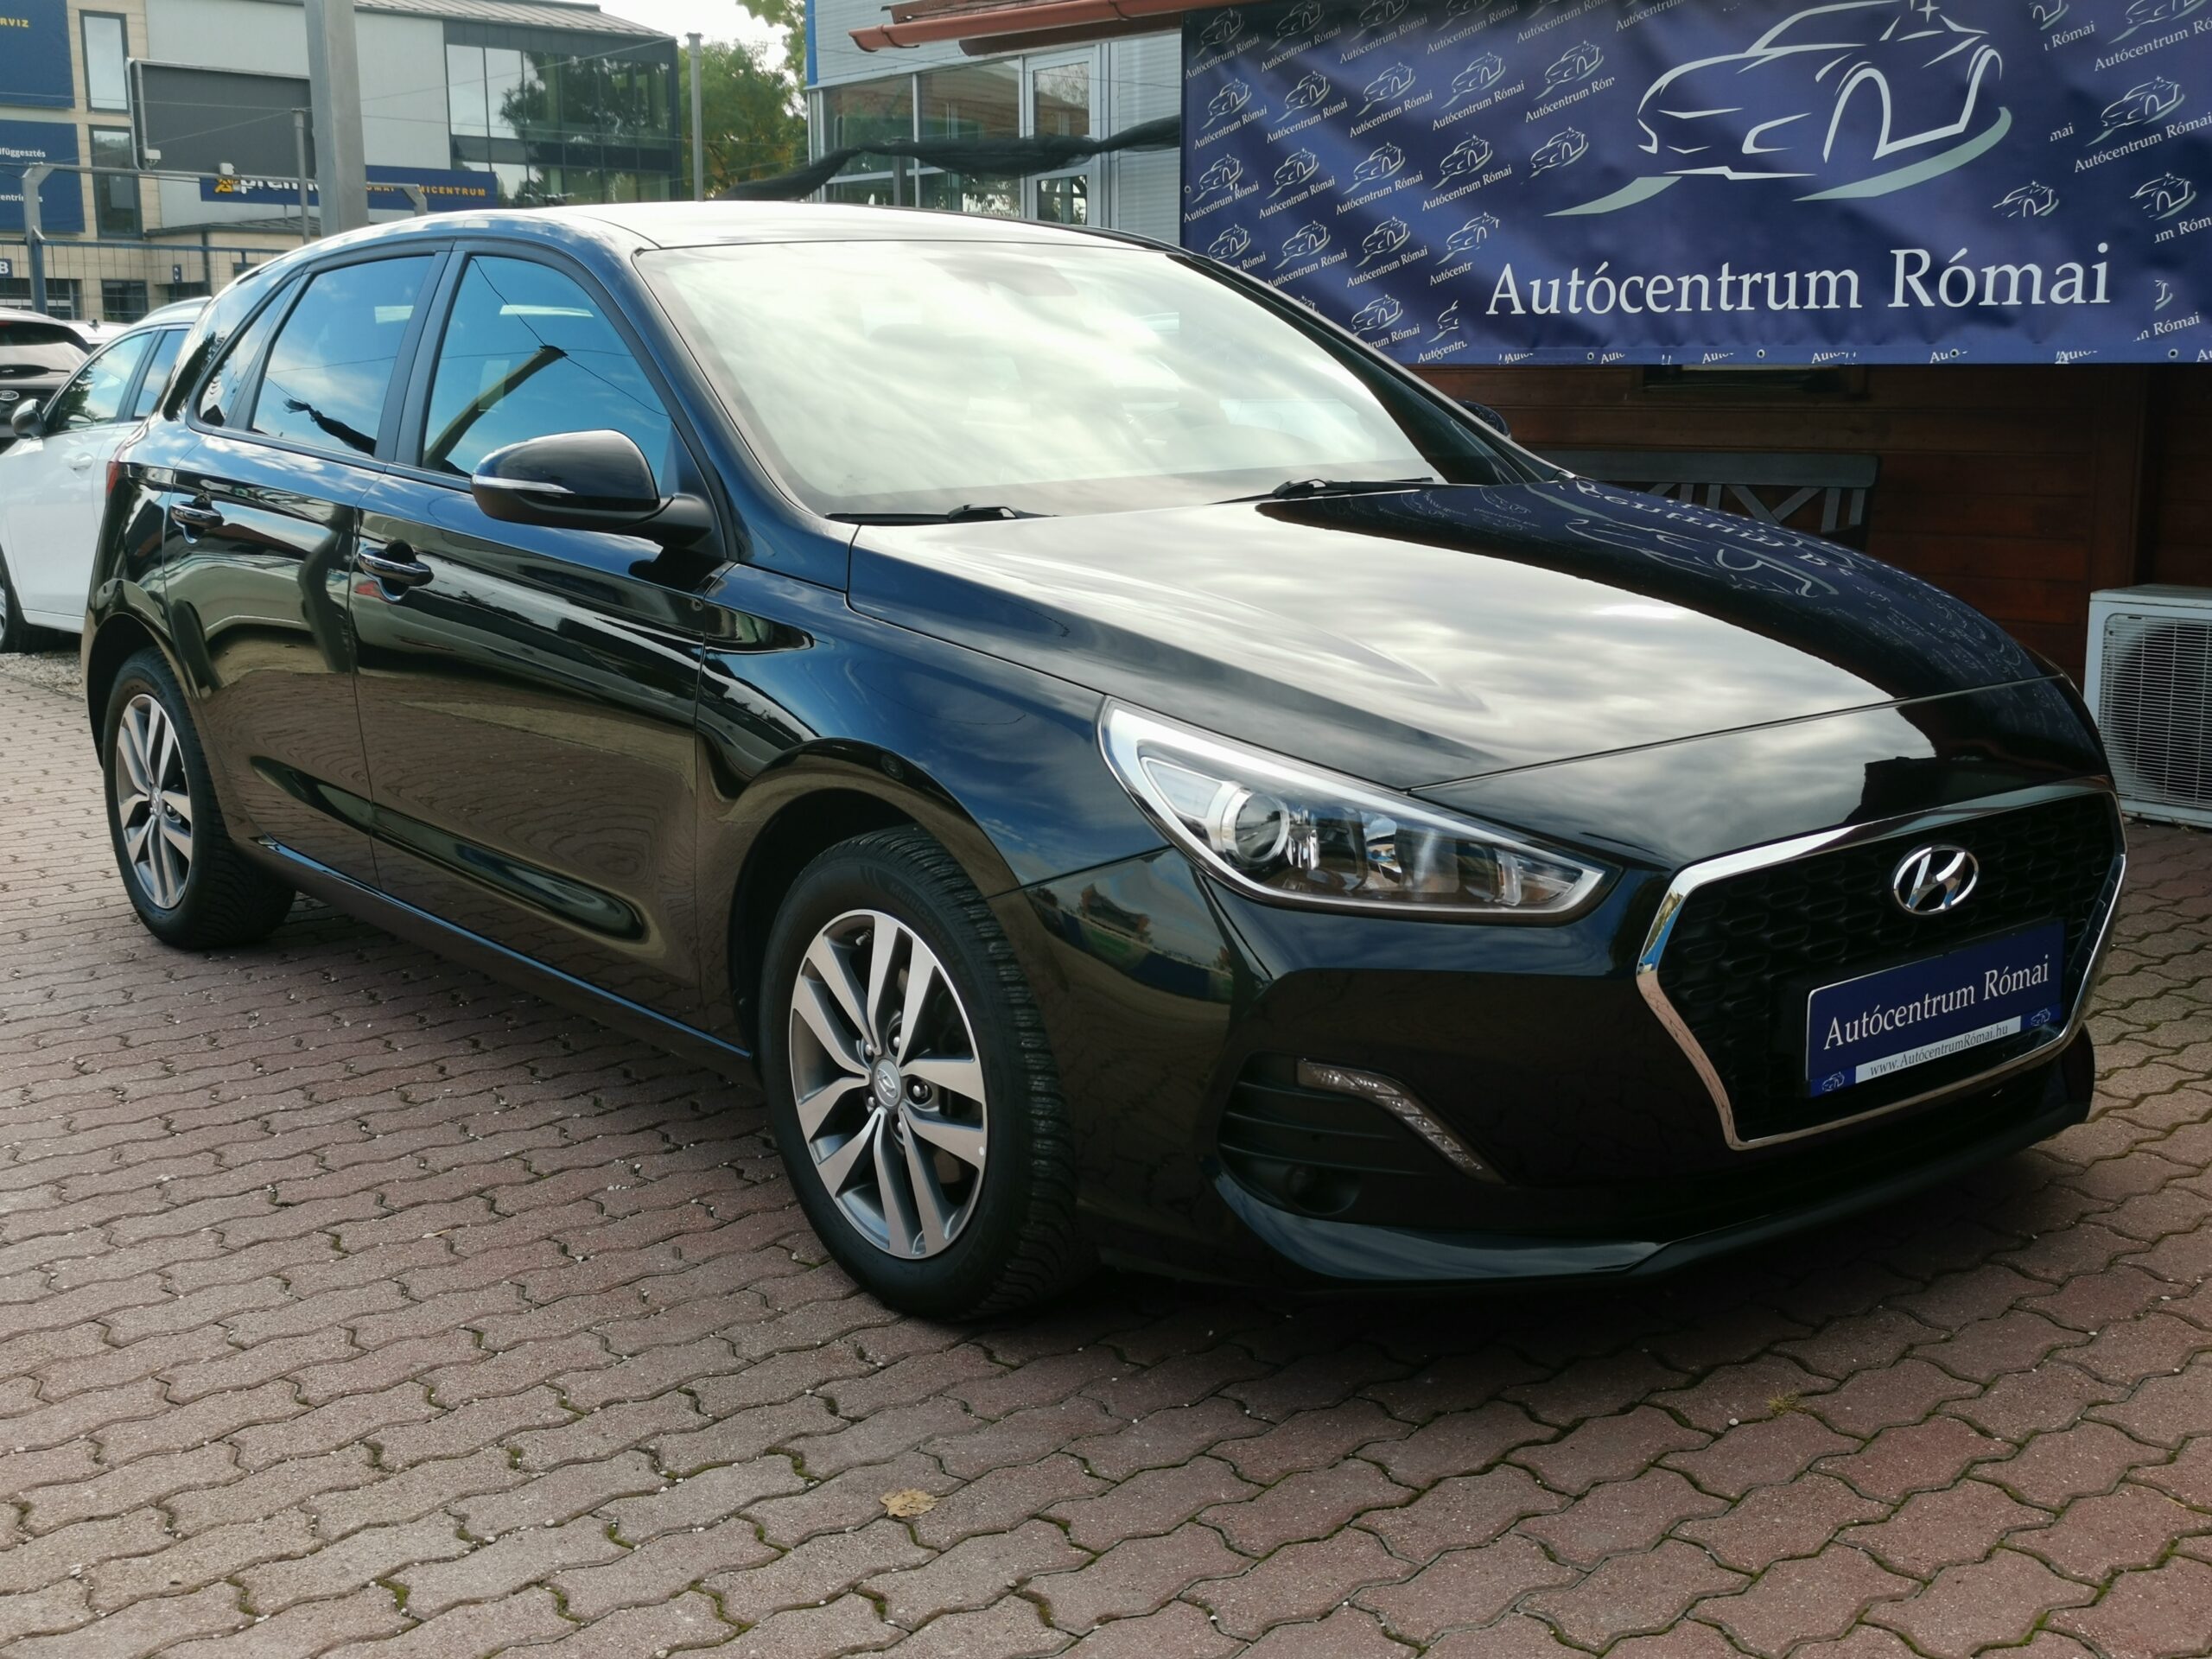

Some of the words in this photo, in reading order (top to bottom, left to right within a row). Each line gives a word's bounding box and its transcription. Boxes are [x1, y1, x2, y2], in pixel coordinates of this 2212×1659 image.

[1339, 32, 1397, 64] Autócentrum
[1399, 14, 1427, 35] Római
[1427, 21, 1487, 54] Autócentrum
[1488, 3, 1518, 24] Római
[1516, 7, 1582, 43] Autócentrum
[2051, 20, 2096, 48] Római
[1185, 48, 1235, 79] Autócentrum
[1236, 34, 1260, 54] Római
[1261, 41, 1312, 73] Autócentrum
[1313, 25, 1341, 46] Római
[2094, 28, 2190, 72] Autócentrum
[1266, 114, 1322, 143] Autócentrum
[1322, 98, 1348, 118] Római
[1350, 105, 1402, 138] Autócentrum
[1403, 89, 1433, 111] Római
[1433, 98, 1492, 130] Autócentrum
[1493, 79, 1525, 103] Római
[1524, 90, 1590, 123] Autócentrum
[1194, 119, 1241, 150] Autócentrum
[1242, 105, 1268, 124] Római
[2075, 132, 2163, 173] Autócentrum
[2165, 111, 2212, 138] Római
[1184, 195, 1233, 223] Autócentrum
[1234, 181, 1260, 200] Római
[1259, 192, 1309, 219] Autócentrum
[1309, 175, 1336, 195] Római
[1336, 186, 1392, 216] Autócentrum
[1394, 170, 1424, 192] Római
[1421, 180, 1481, 212] Autócentrum
[1483, 163, 1513, 187] Római
[1242, 251, 1267, 271] Római
[1320, 248, 1348, 268] Római
[1346, 261, 1401, 288] Autócentrum
[1401, 245, 1428, 265] Római
[1485, 261, 1863, 315] Autócentrum
[1887, 242, 2111, 308] Római
[1391, 323, 1421, 343] Római
[2153, 311, 2200, 336] Római
[1823, 985, 1975, 1050] Autócentrum
[1983, 954, 2049, 1001] Római
[1870, 1023, 2008, 1077] www.AutócentrumRómai.hu
